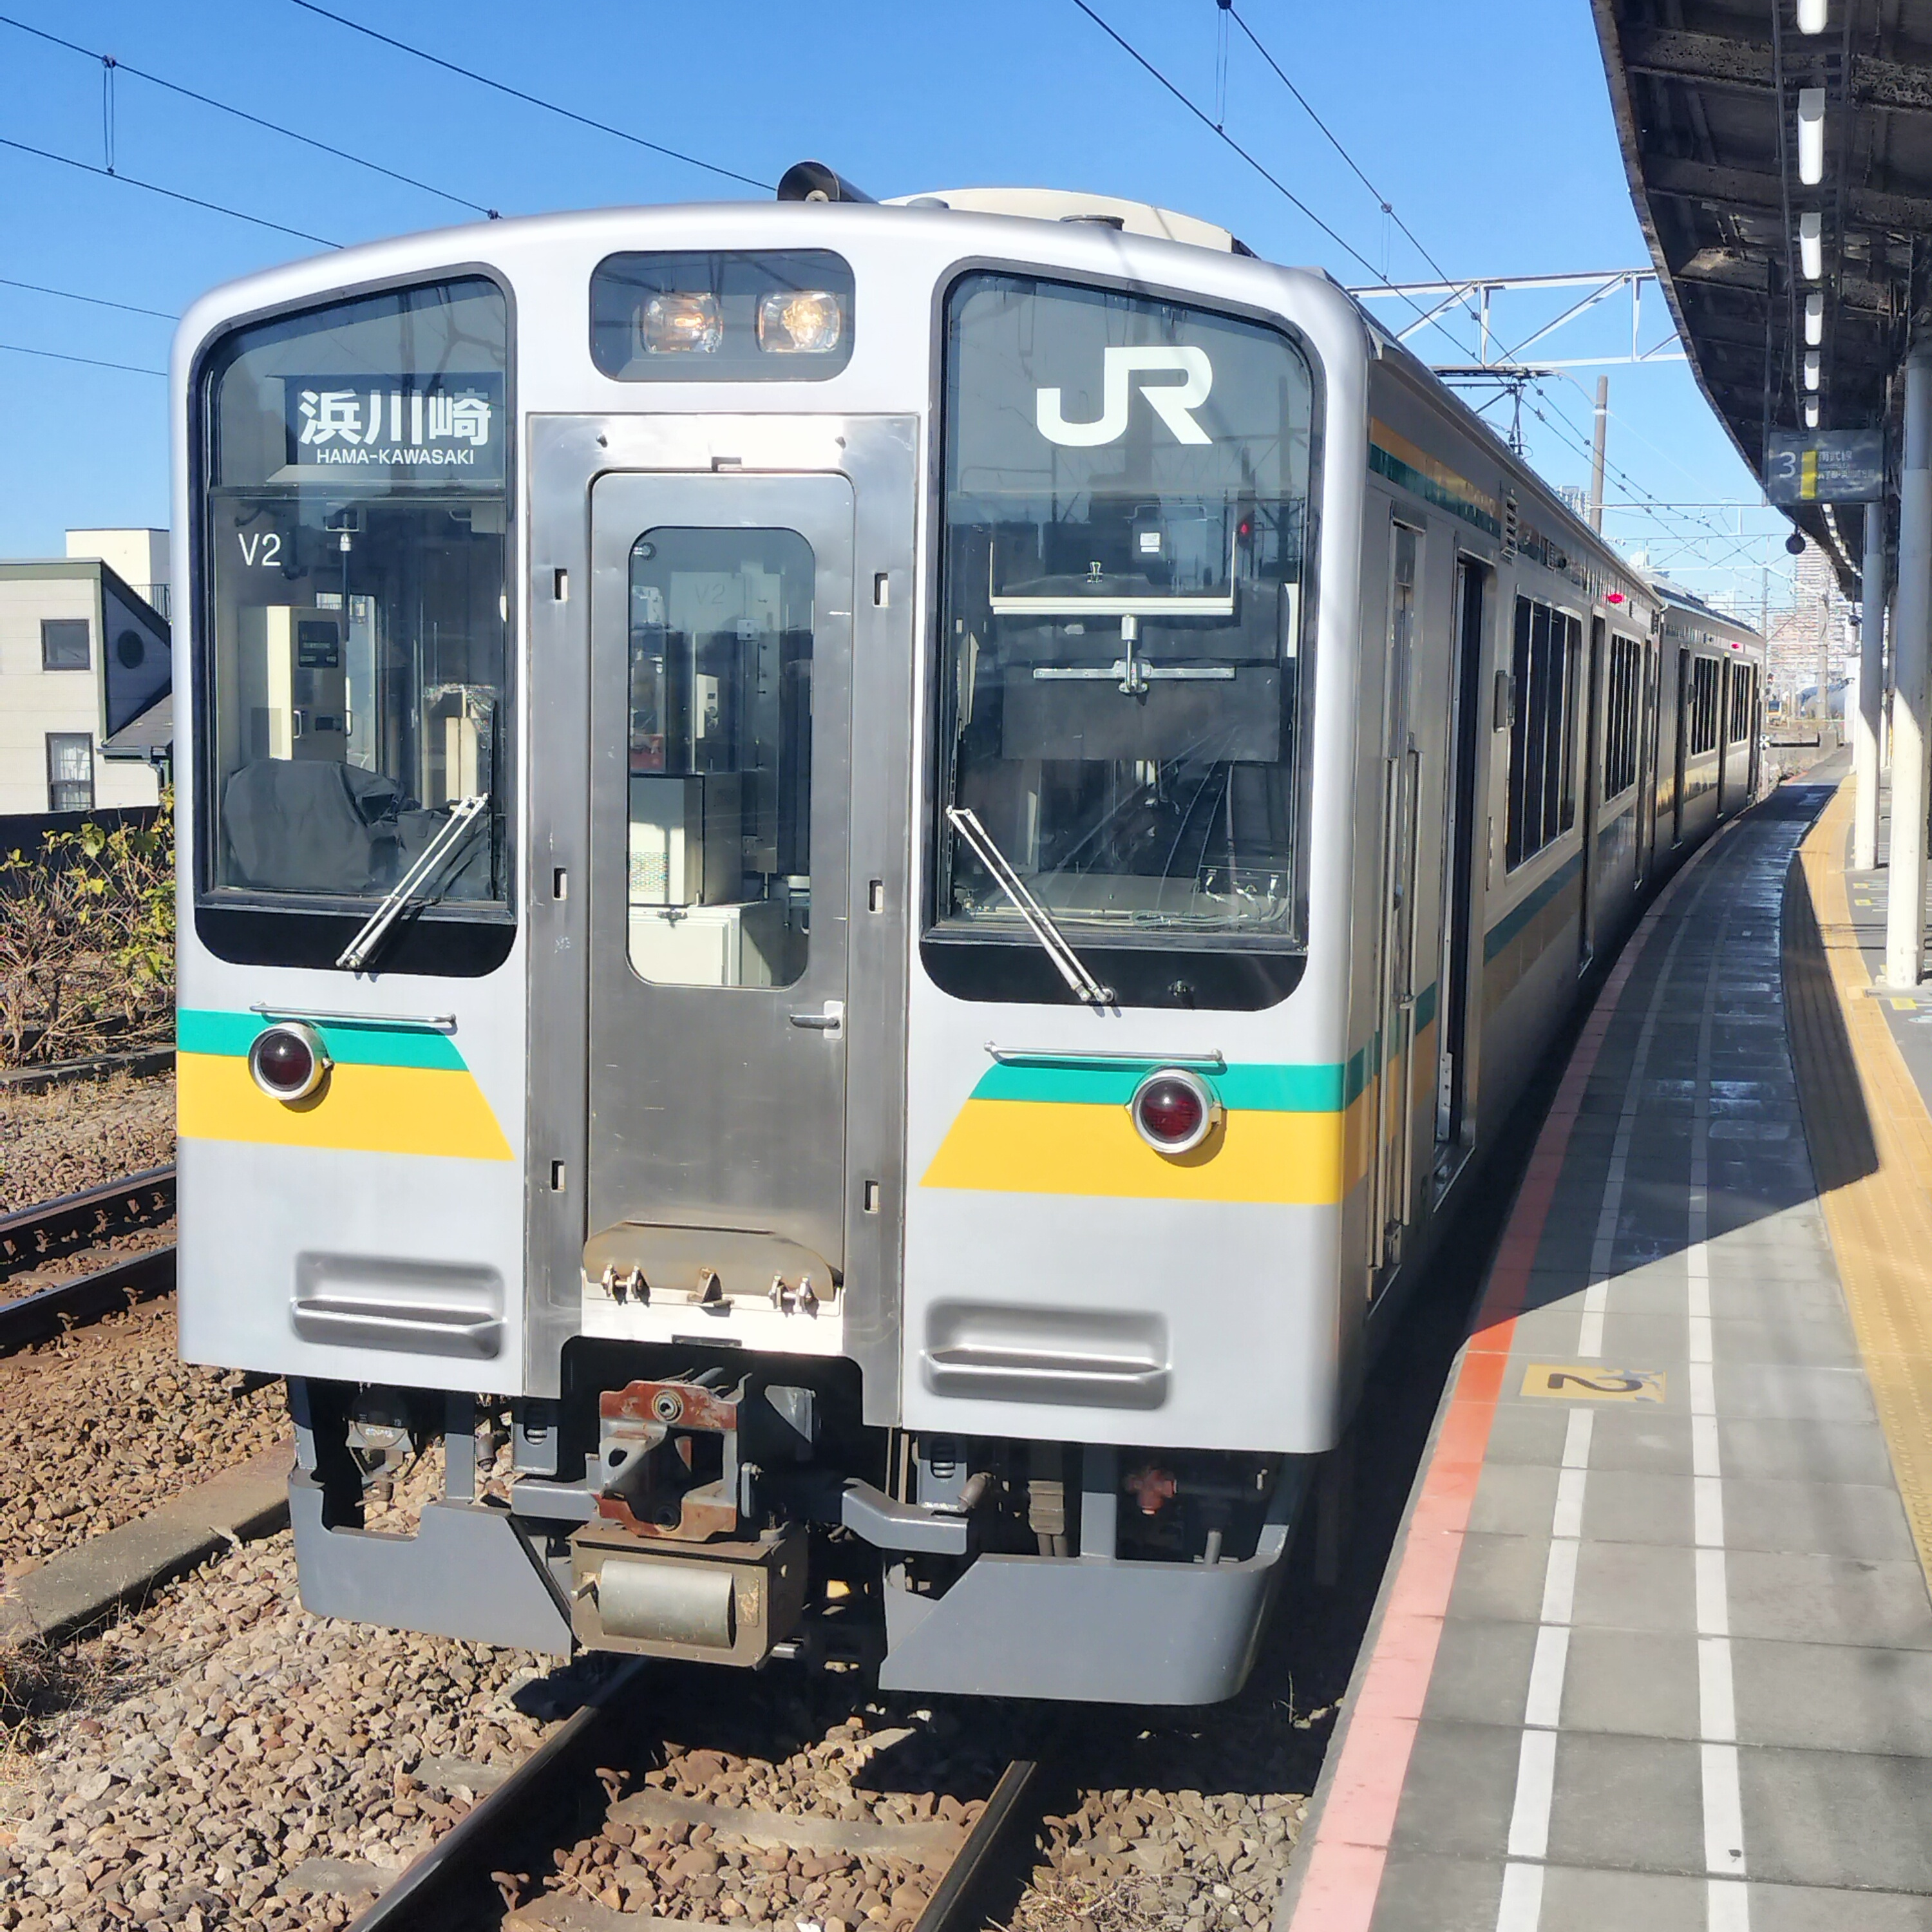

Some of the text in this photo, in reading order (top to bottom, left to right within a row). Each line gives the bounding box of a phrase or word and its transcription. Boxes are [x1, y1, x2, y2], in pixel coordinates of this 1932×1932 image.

[1037, 346, 1213, 446] JR
[299, 388, 491, 446] 浜川崎
[317, 448, 474, 464] HAMA-KAWASAKI
[1779, 451, 1797, 478] 3
[238, 533, 281, 567] V2
